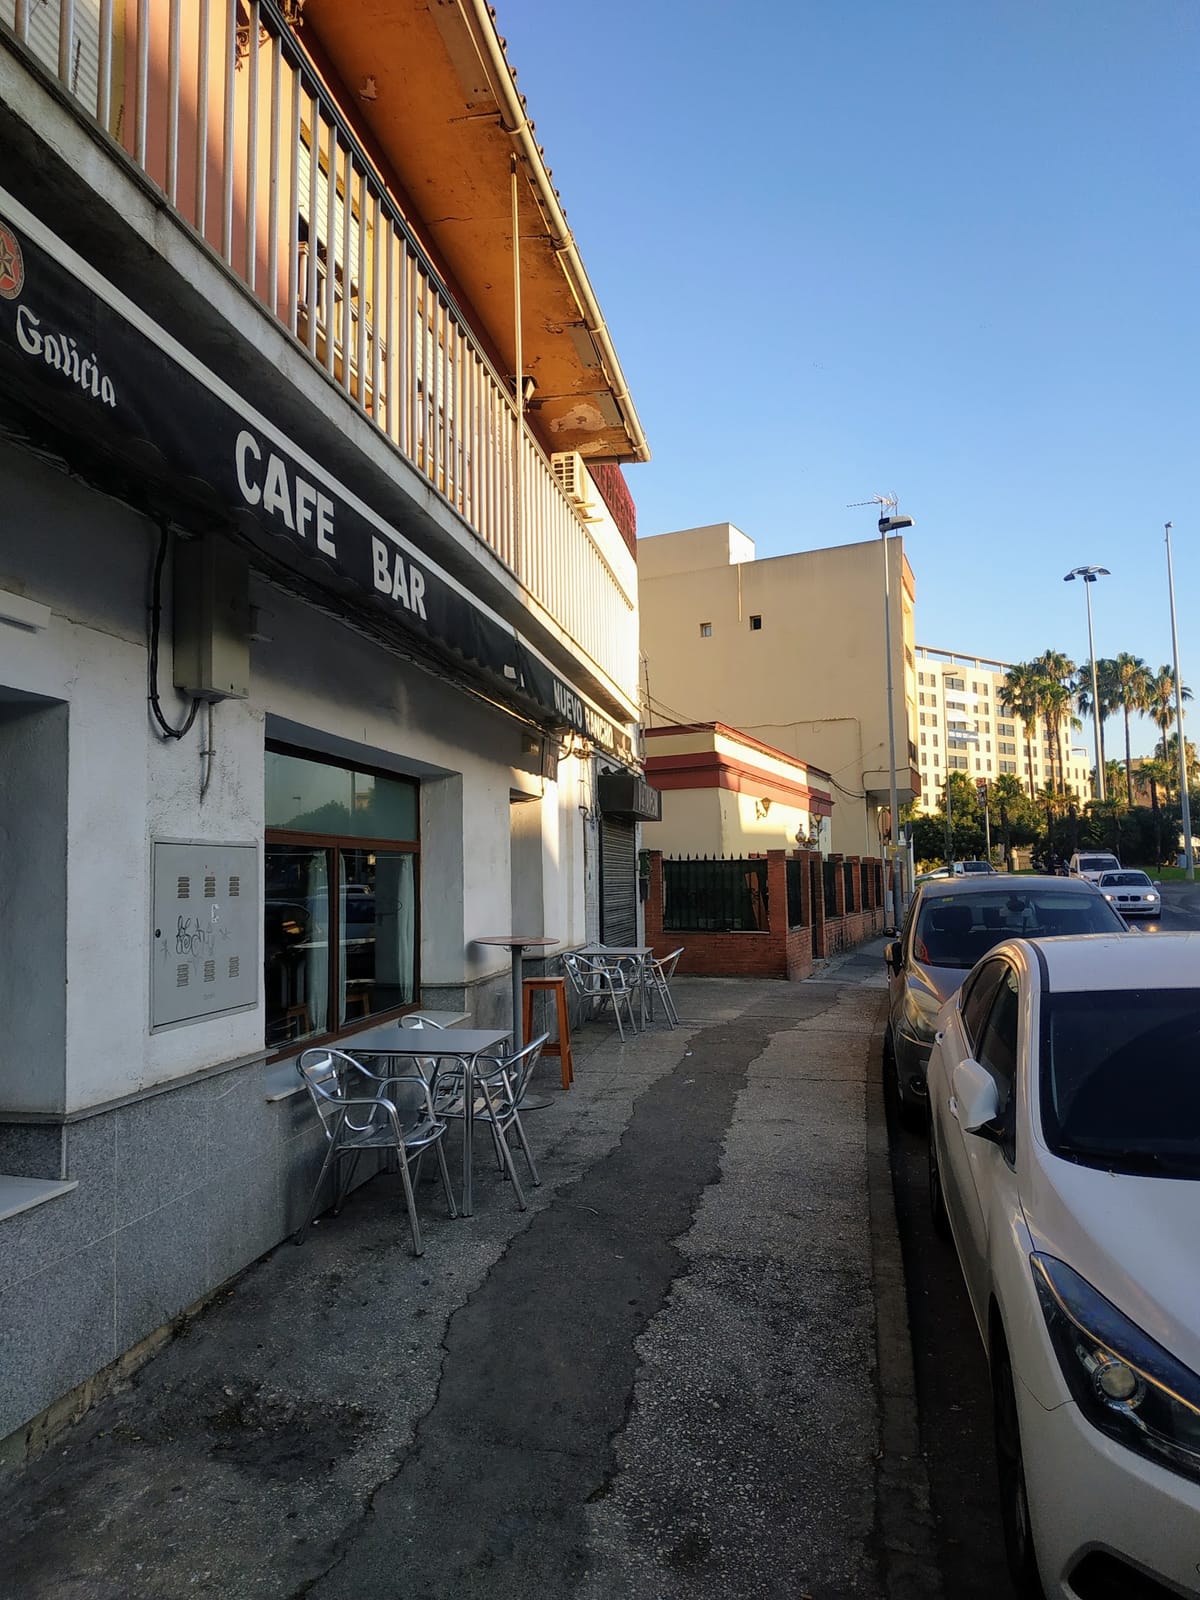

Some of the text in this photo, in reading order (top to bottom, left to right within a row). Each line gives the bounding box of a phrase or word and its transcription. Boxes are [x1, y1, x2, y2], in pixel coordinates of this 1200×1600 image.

[15, 304, 117, 408] Galicia
[235, 430, 428, 621] CAFE BAR
[553, 679, 583, 729] NUEVO
